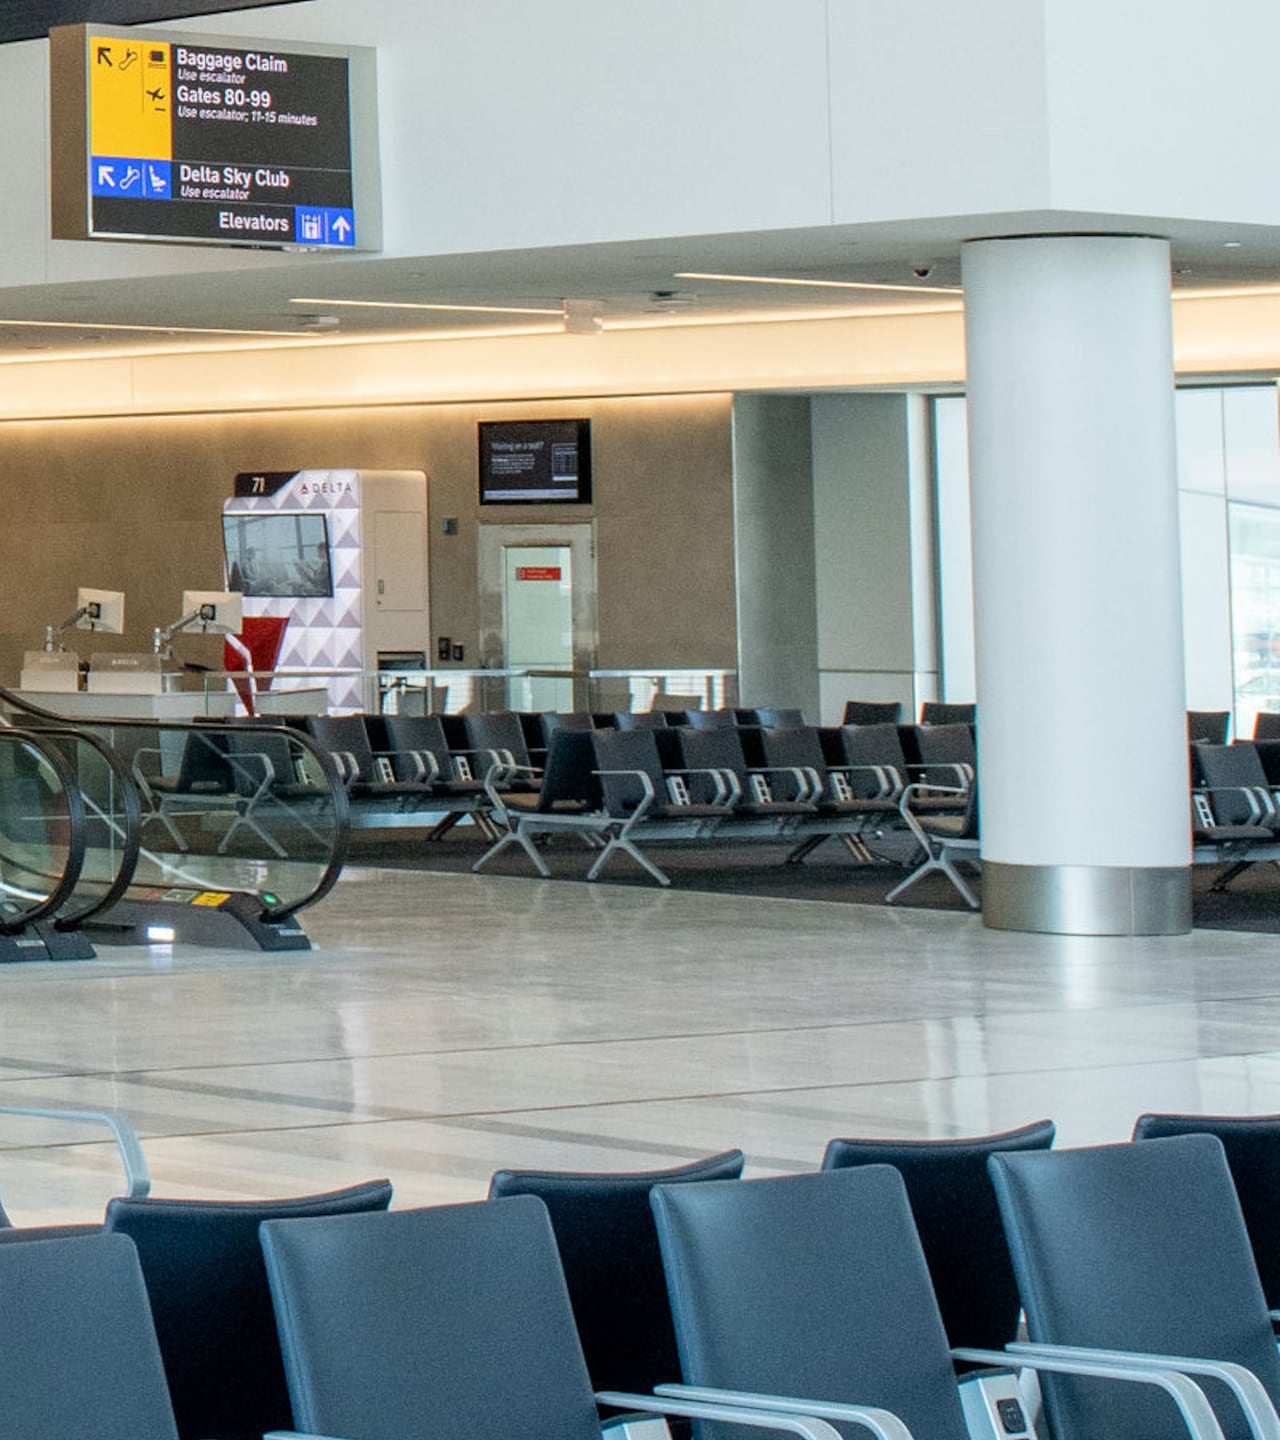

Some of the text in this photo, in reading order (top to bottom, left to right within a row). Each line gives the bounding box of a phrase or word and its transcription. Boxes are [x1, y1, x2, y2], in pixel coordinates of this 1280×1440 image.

[176, 48, 288, 72] Baggage Claim
[178, 69, 247, 85] Use escalator
[176, 85, 272, 108] Gates 80-99
[178, 106, 198, 118] Use
[251, 111, 277, 124] 11-15
[278, 113, 318, 126] minutes
[180, 164, 290, 189] Delta Sky Club
[180, 185, 250, 200] Use escalator
[219, 210, 290, 232] Elevators
[250, 477, 266, 494] 71
[312, 482, 352, 494] DELTA
